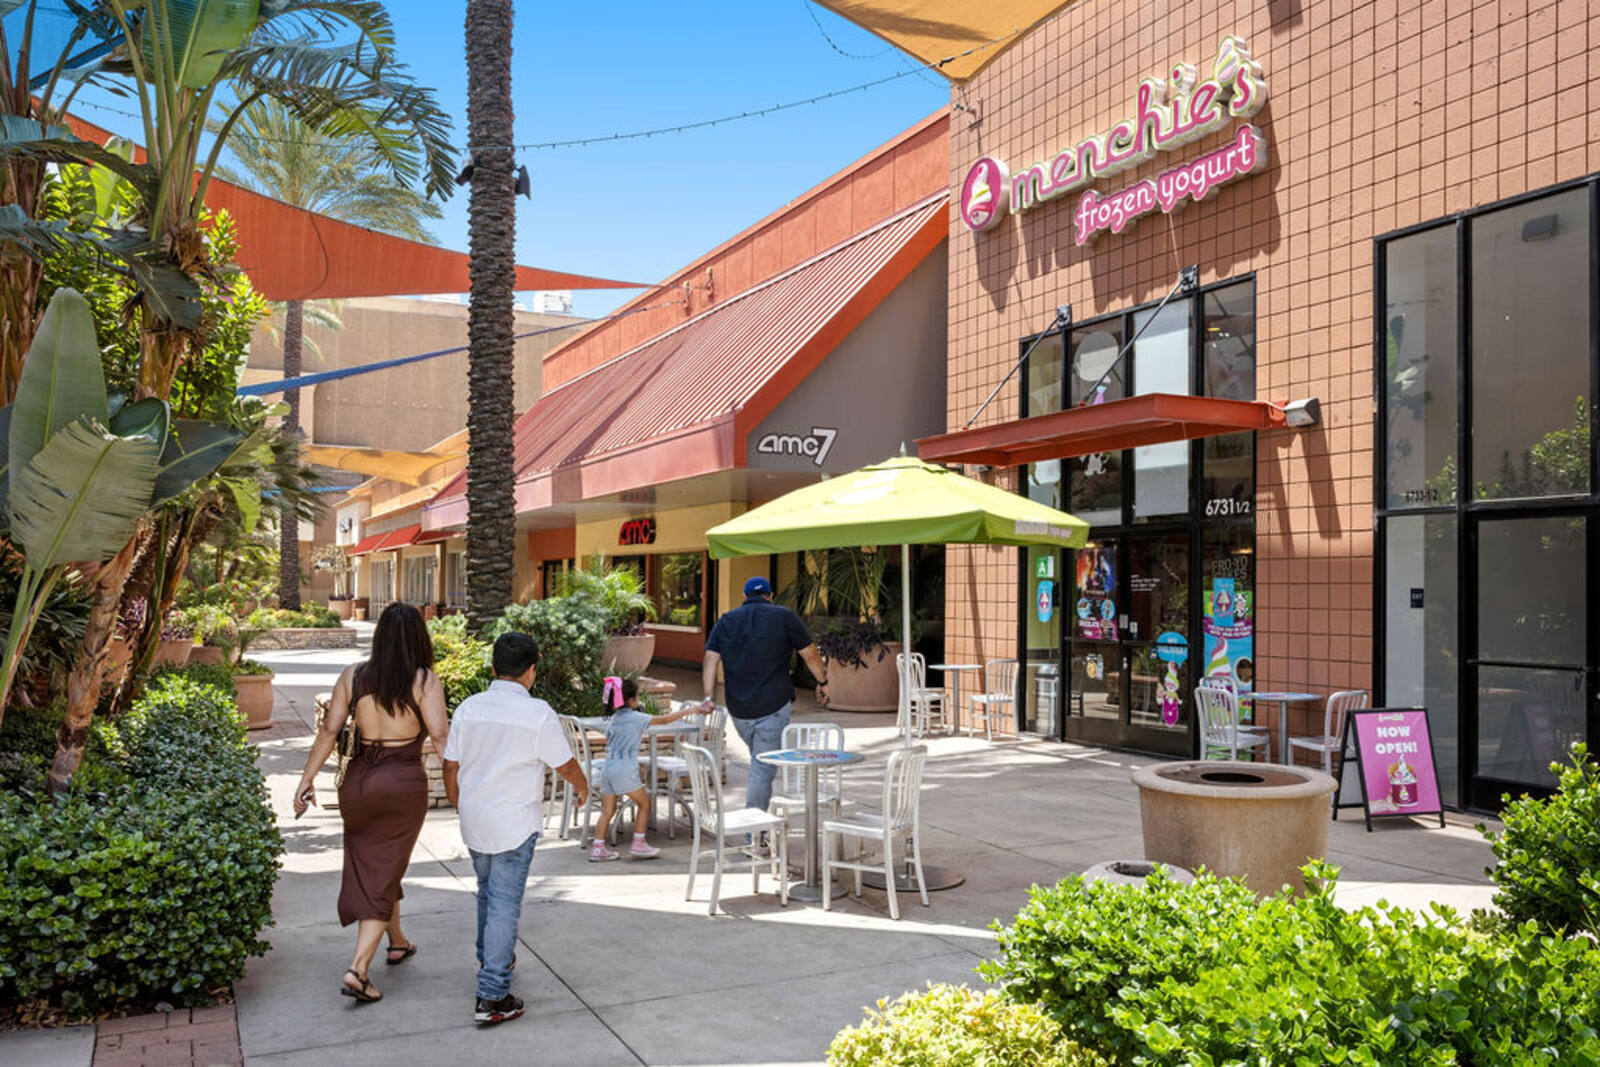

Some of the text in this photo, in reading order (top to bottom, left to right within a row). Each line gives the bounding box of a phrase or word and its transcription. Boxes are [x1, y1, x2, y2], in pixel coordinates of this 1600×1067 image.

[1010, 35, 1266, 214] menchie's
[1077, 132, 1254, 242] frozen yogurt
[1205, 497, 1234, 516] 6731
[1038, 561, 1047, 573] A
[1376, 726, 1411, 738] NOW
[1375, 741, 1417, 754] OPEN!
